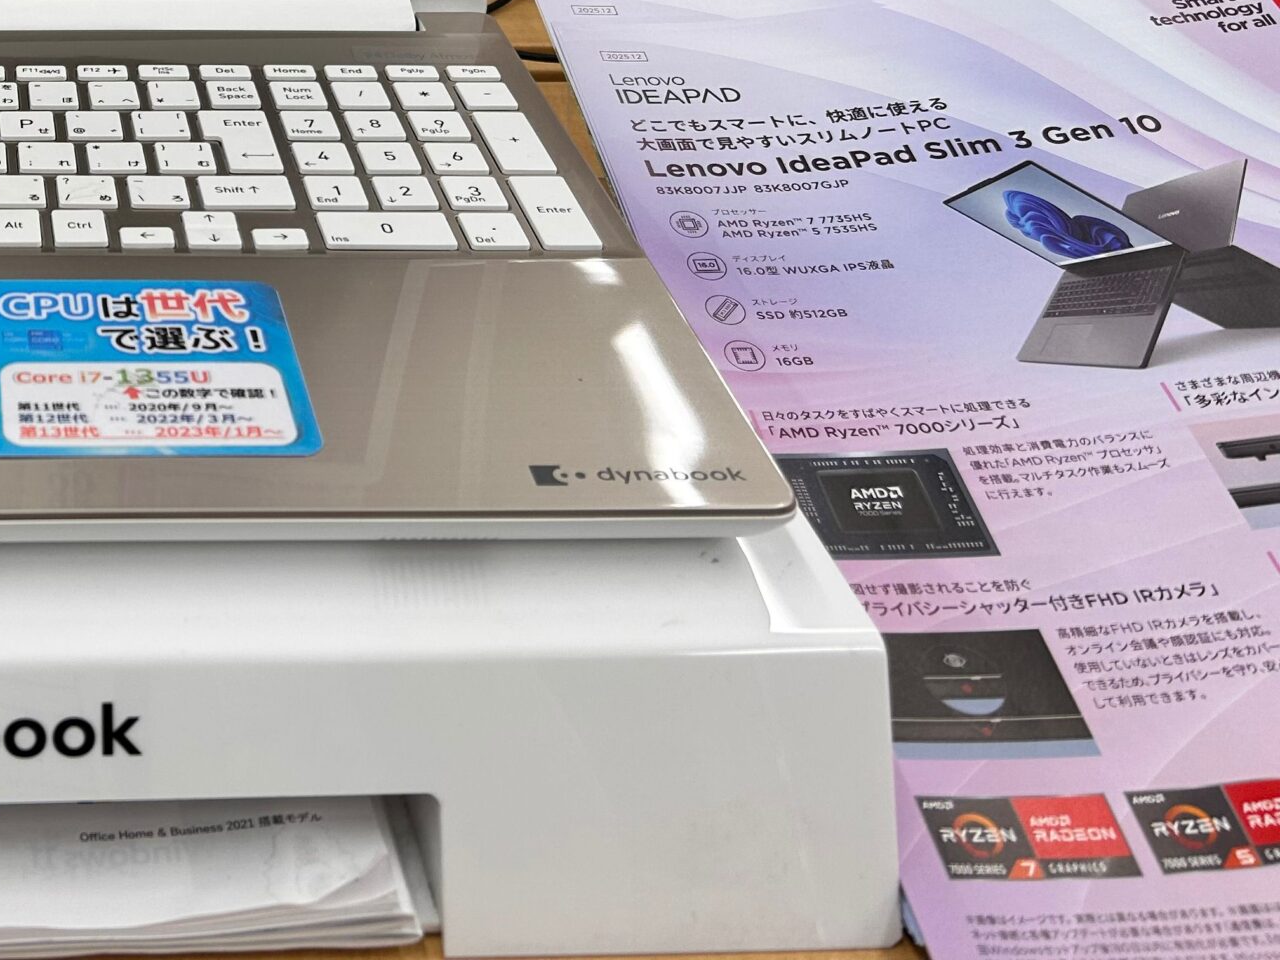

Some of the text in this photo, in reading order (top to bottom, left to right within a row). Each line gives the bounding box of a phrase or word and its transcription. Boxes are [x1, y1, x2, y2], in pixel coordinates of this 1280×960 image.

[1150, 2, 1264, 26] technology
[1218, 14, 1277, 33] for all
[609, 74, 685, 86] Lenovo
[283, 86, 312, 94] Num
[615, 87, 741, 105] IDEAPAD
[218, 93, 254, 102] Space
[285, 93, 313, 101] Lock
[223, 118, 263, 128] Enter
[639, 117, 951, 152] 大画面で見やすいスリムノートPC
[644, 114, 1162, 178] Lenovo IdeaPad Slim 3 Gen 10
[214, 186, 245, 194] Shift
[656, 179, 849, 195] 83K8007JJP 83K8007GJP
[536, 206, 572, 214] Enter
[4, 221, 23, 230] Alt
[67, 220, 93, 230] Ctrl
[717, 219, 748, 228] AMD
[806, 217, 815, 225] 7
[818, 213, 872, 224] 7735HS
[722, 229, 753, 238] AMD
[811, 227, 821, 235] 5
[823, 223, 878, 235] 7535HS
[783, 264, 840, 275] WUXGA
[756, 308, 848, 320] SSD 約512GB
[773, 344, 798, 352] メモリ
[776, 356, 814, 366] 16GB
[15, 368, 210, 386] Core i7-1355U
[596, 467, 747, 485] dynabook
[850, 487, 889, 499] AMD
[854, 501, 902, 511] RYZEN
[80, 831, 116, 842] Office
[119, 829, 154, 840] Home
[170, 824, 224, 838] Business
[227, 819, 255, 831] 2021
[1151, 816, 1231, 837] RYZEN
[939, 827, 1018, 842] RYZEN
[1033, 826, 1117, 842] RADEON
